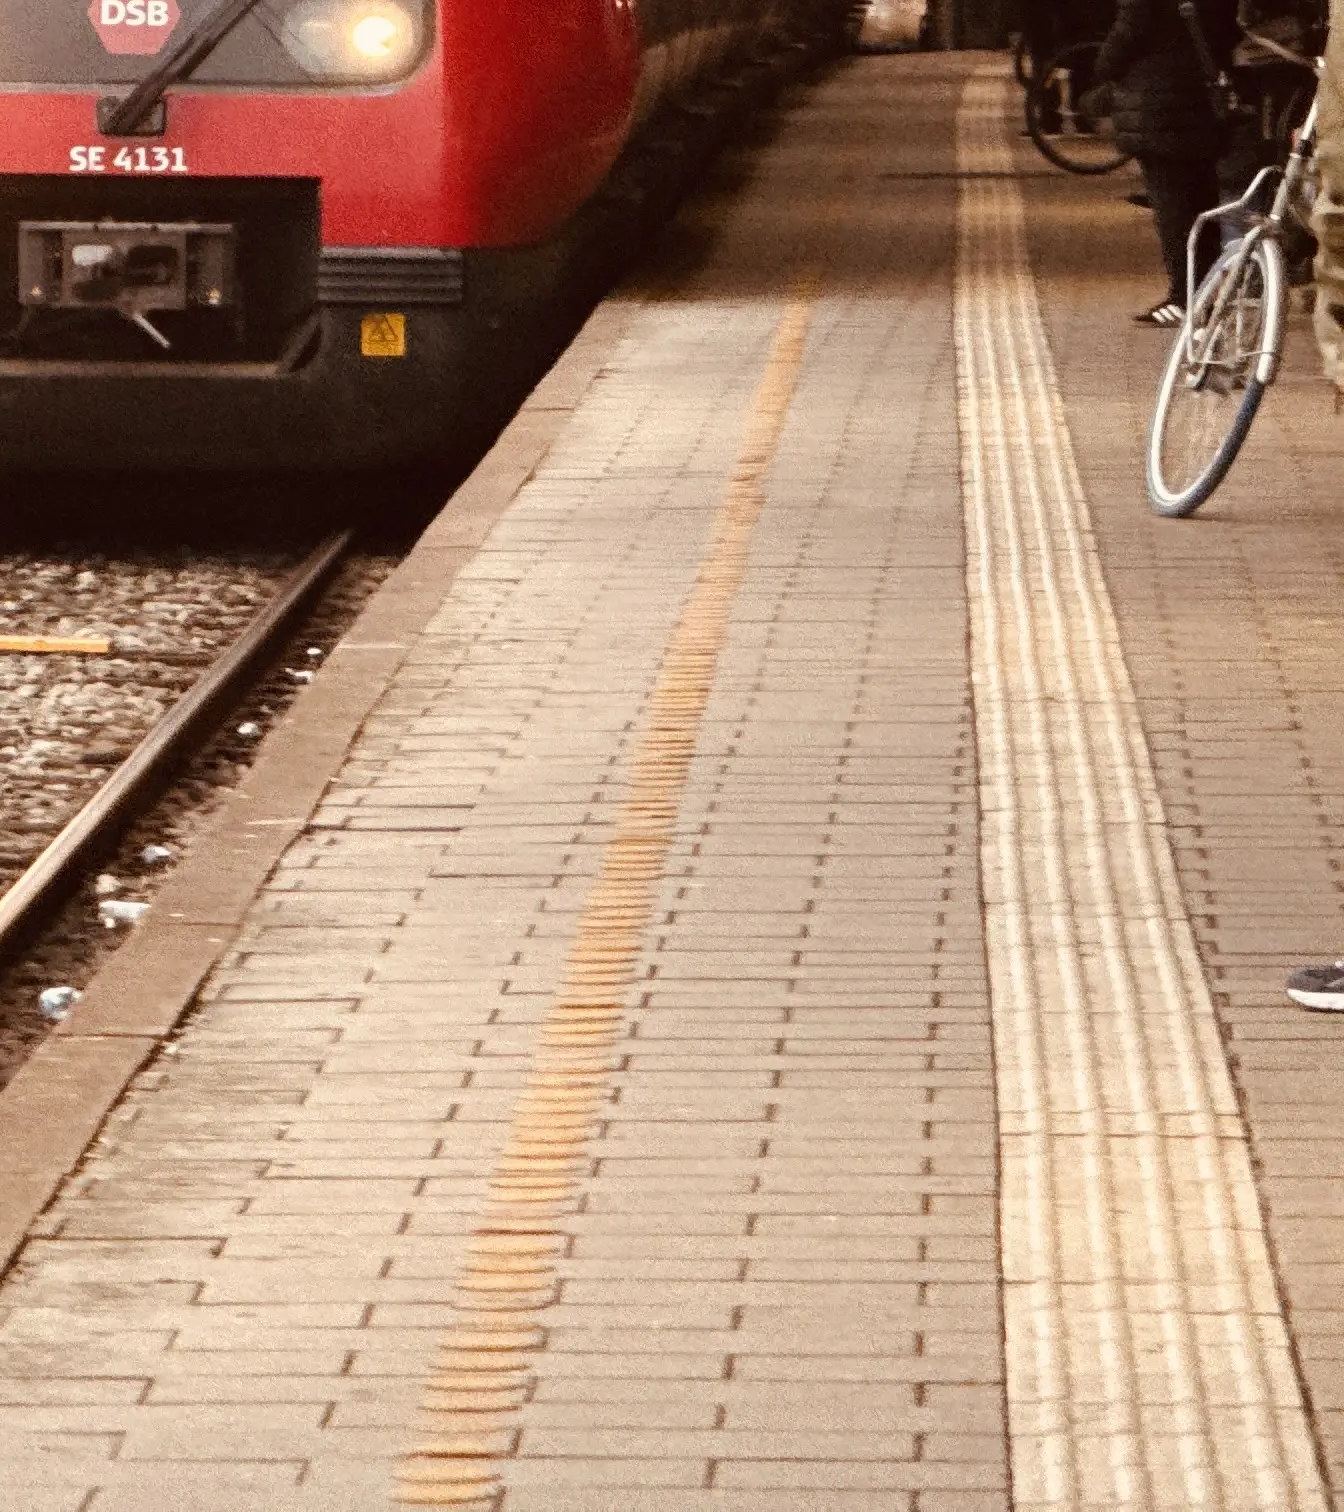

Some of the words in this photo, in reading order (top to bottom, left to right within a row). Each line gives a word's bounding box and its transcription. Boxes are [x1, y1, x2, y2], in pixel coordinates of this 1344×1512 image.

[100, 0, 169, 26] DSB
[69, 146, 105, 172] SE
[113, 146, 188, 172] 4131
